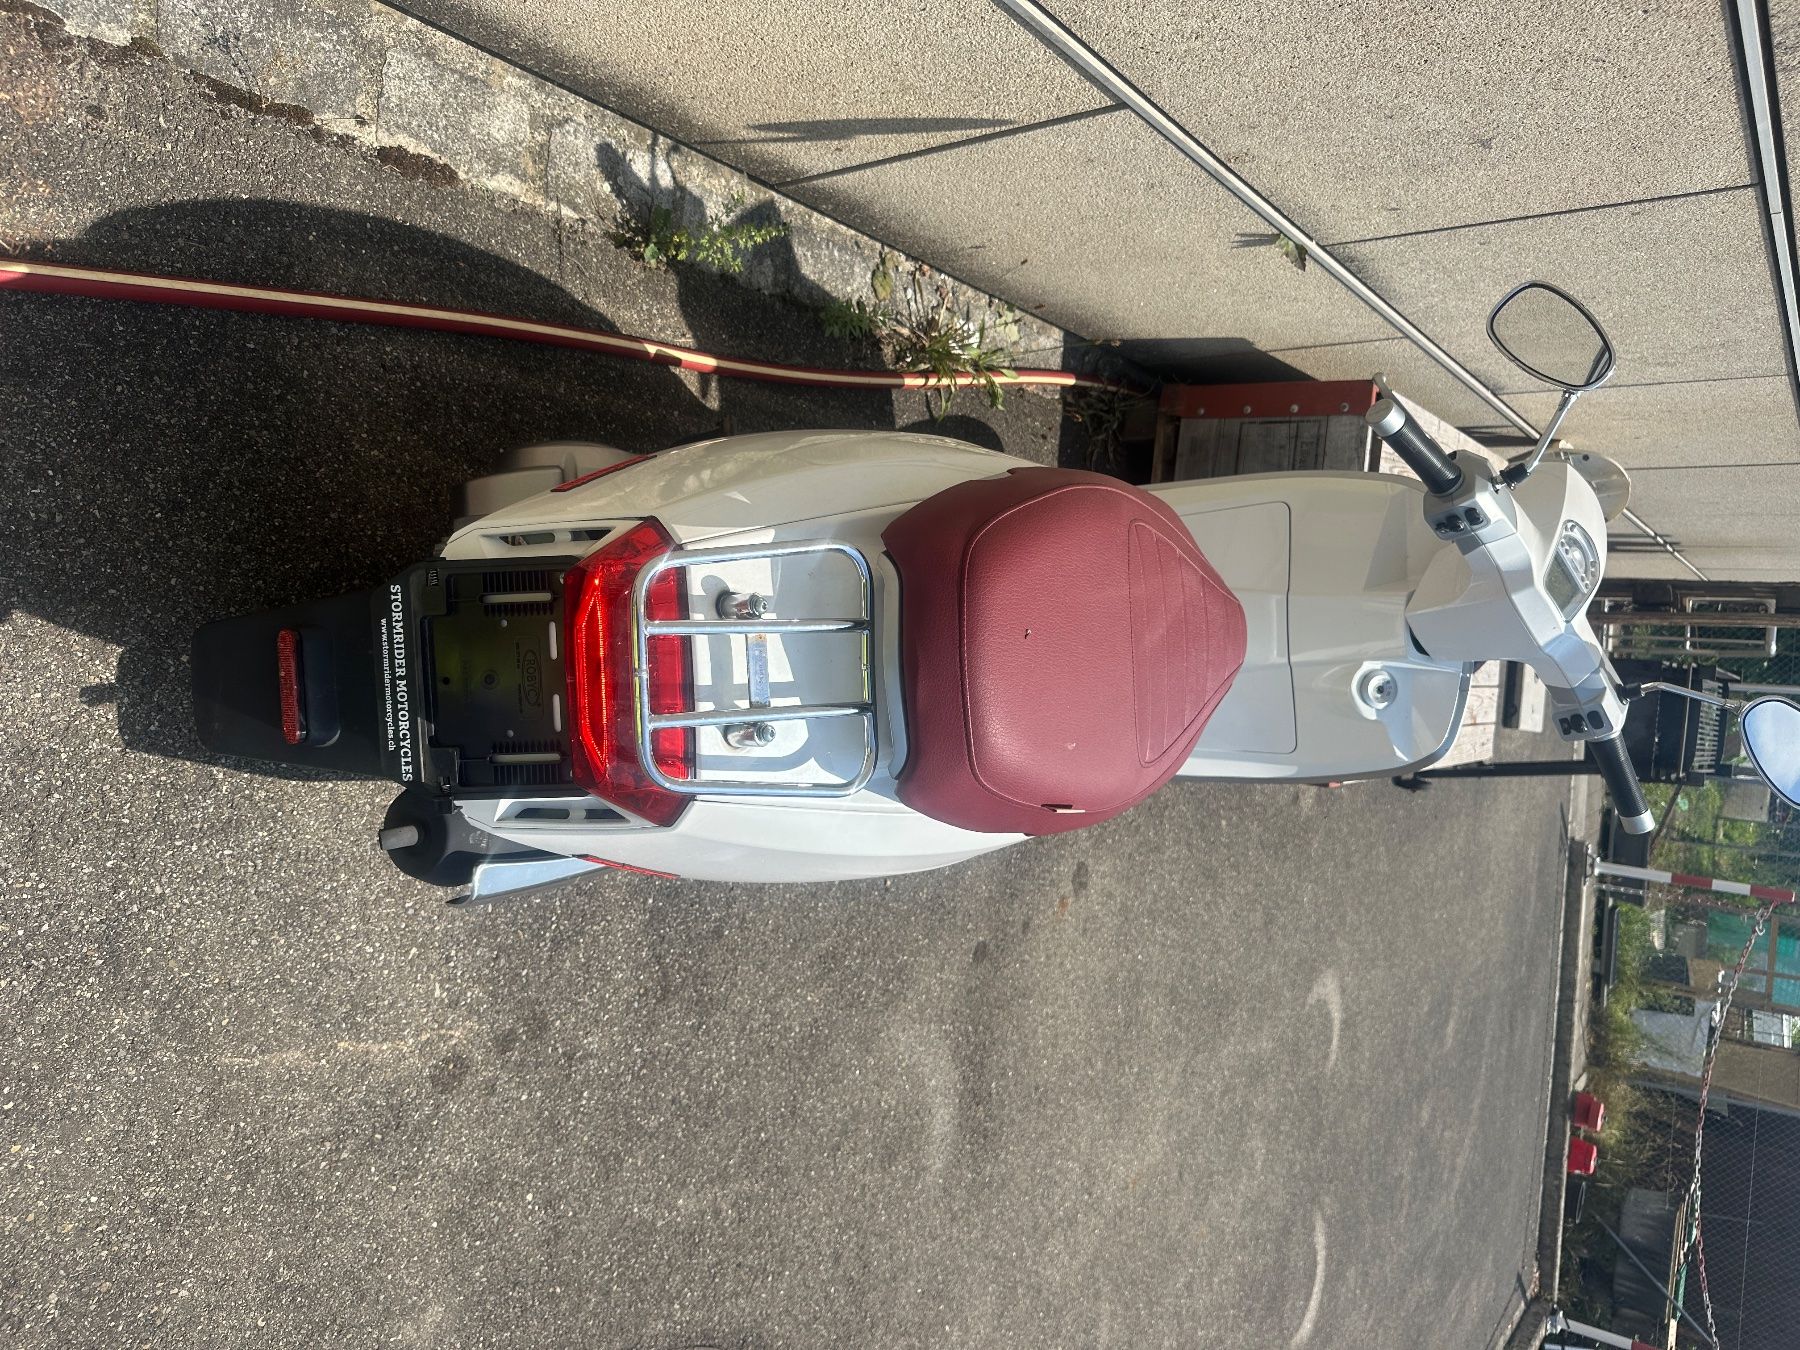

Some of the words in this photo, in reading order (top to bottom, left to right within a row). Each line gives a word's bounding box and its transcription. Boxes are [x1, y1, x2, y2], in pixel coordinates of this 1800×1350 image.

[390, 584, 407, 677] STORMRIDER
[381, 618, 397, 751] www.stormridermotorcycles.ch
[396, 679, 413, 782] MOTORCYCLES
